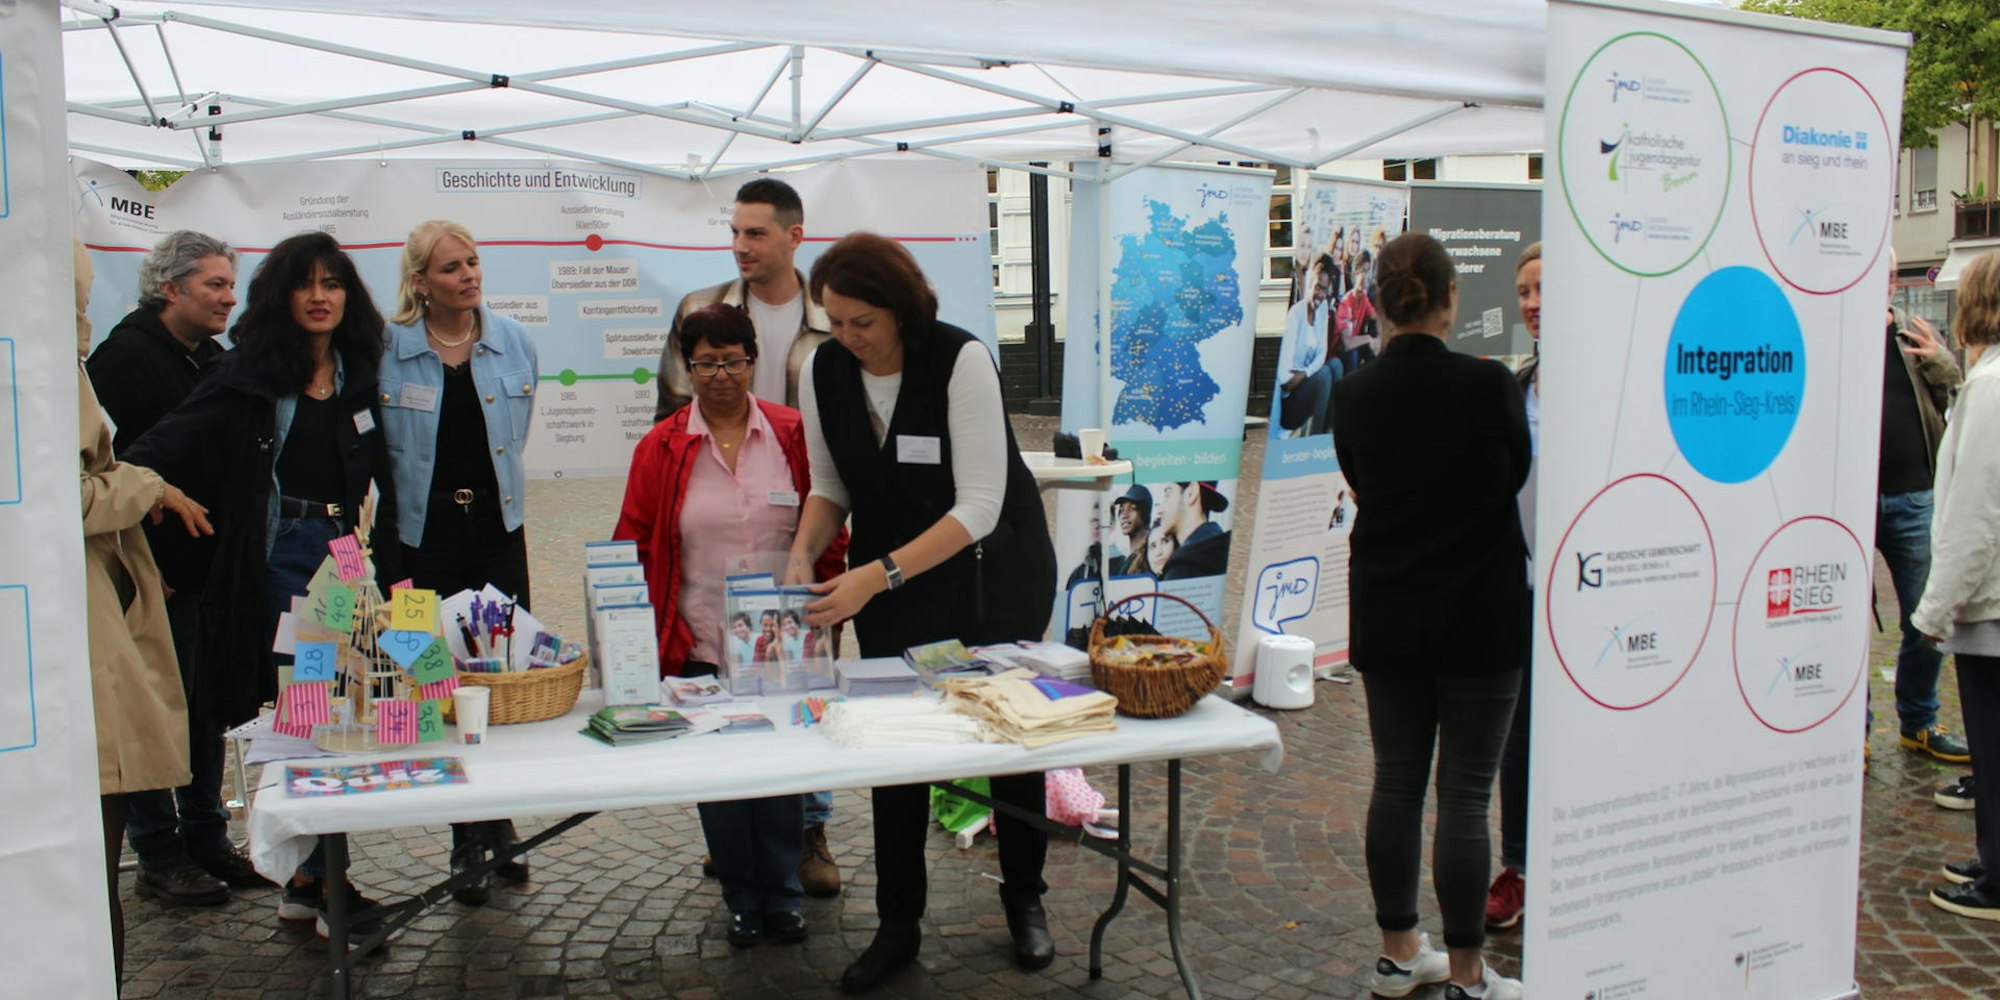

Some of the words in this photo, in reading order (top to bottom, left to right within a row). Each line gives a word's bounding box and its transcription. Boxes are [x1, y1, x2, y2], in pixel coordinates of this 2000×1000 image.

[1628, 131, 1685, 150] katholische
[1782, 125, 1852, 149] Diakonie
[1629, 151, 1702, 170] jugendagentur
[1782, 153, 1795, 164] an
[1797, 153, 1820, 169] sieg
[1822, 155, 1841, 167] und
[1844, 156, 1868, 169] rhein
[442, 170, 521, 188] Geschichte
[524, 171, 550, 188] und
[554, 171, 636, 197] Entwicklung
[111, 196, 156, 220] MBE
[1429, 228, 1521, 242] Migrationsberatung
[1819, 221, 1848, 239] MBE
[592, 266, 605, 275] der
[606, 265, 629, 275] Mauer
[594, 280, 607, 288] aus
[608, 279, 621, 288] der
[1676, 343, 1794, 381] Integration
[1671, 394, 1689, 417] im
[1690, 390, 1795, 421] Rhein-Sieg-Kreis
[1136, 453, 1186, 470] begleiten
[1193, 451, 1226, 465] bilden
[1793, 562, 1847, 585] RHEIN
[404, 593, 425, 619] 25
[1792, 585, 1833, 607] SIEG
[331, 595, 346, 624] 40
[1627, 632, 1657, 652] MBE
[303, 648, 324, 676] 28
[419, 644, 444, 671] 38
[1793, 663, 1823, 681] MBE
[292, 766, 442, 795] Quiz
